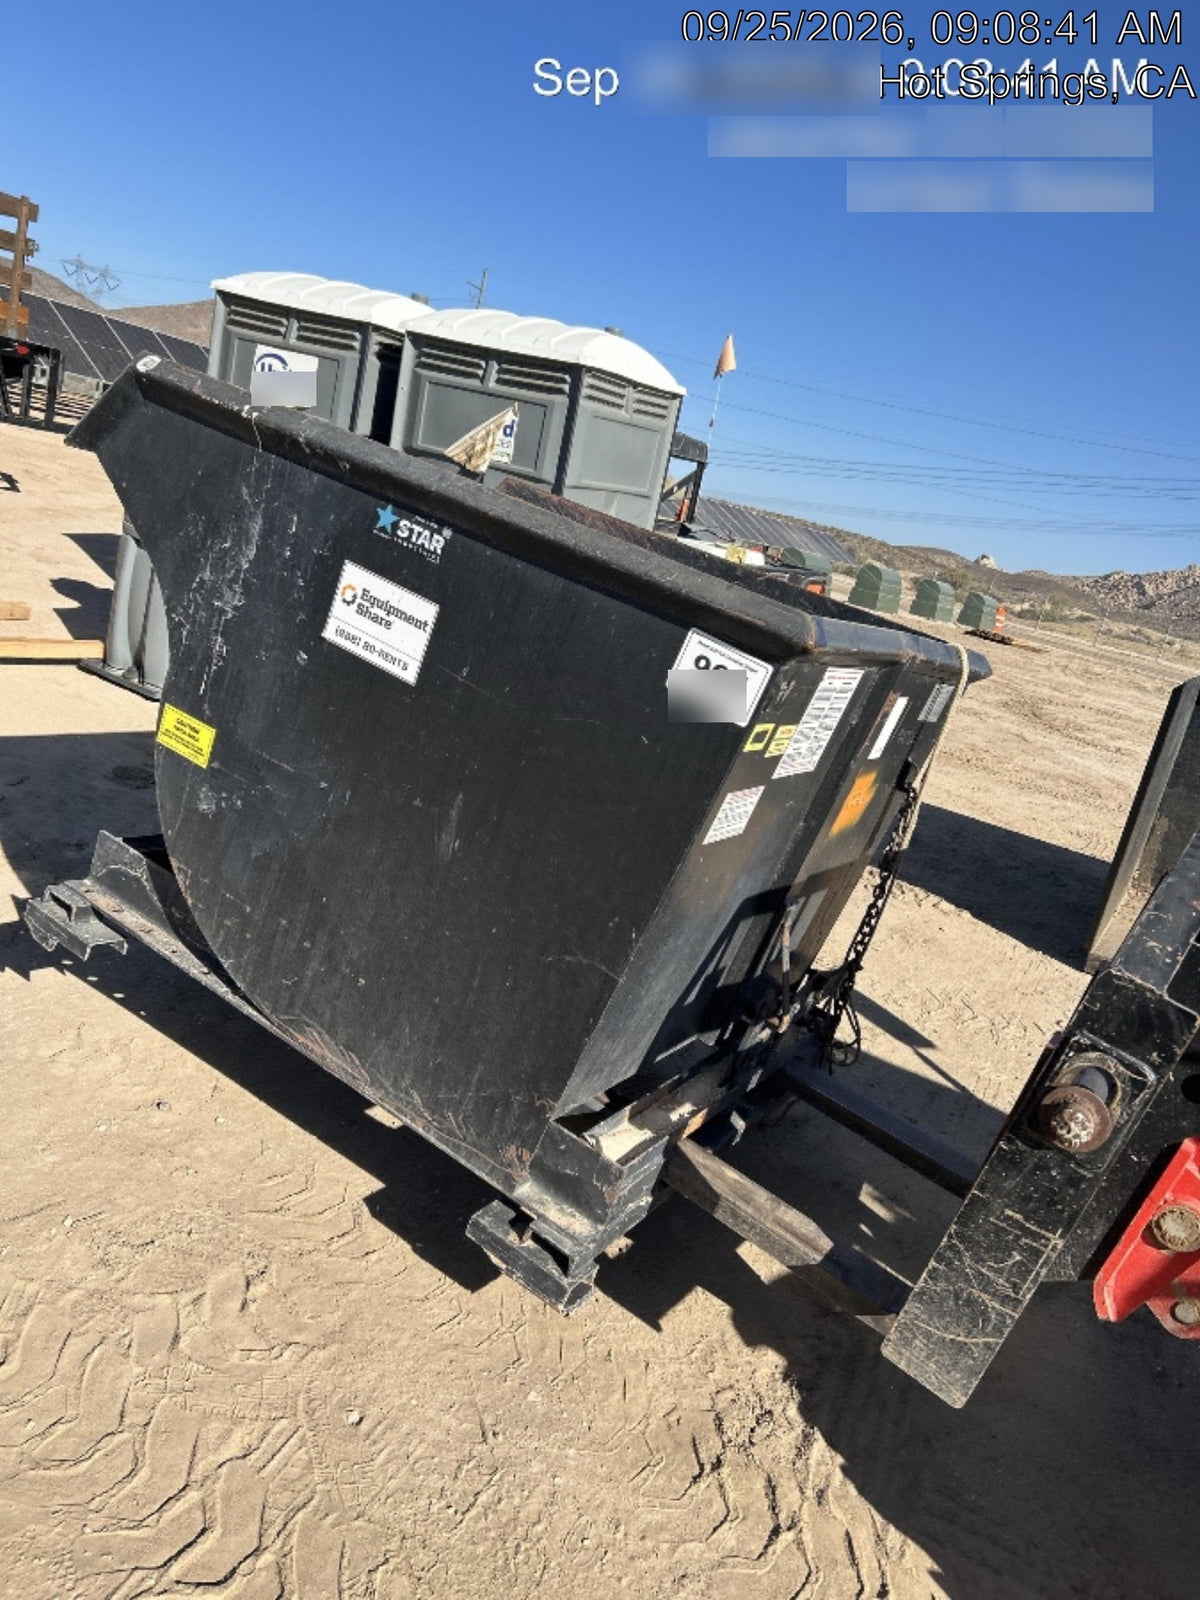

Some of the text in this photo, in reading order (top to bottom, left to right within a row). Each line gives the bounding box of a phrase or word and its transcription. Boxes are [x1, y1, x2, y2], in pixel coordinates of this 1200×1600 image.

[397, 518, 446, 556] STAR
[355, 602, 393, 630] Share
[360, 587, 429, 633] Equipment
